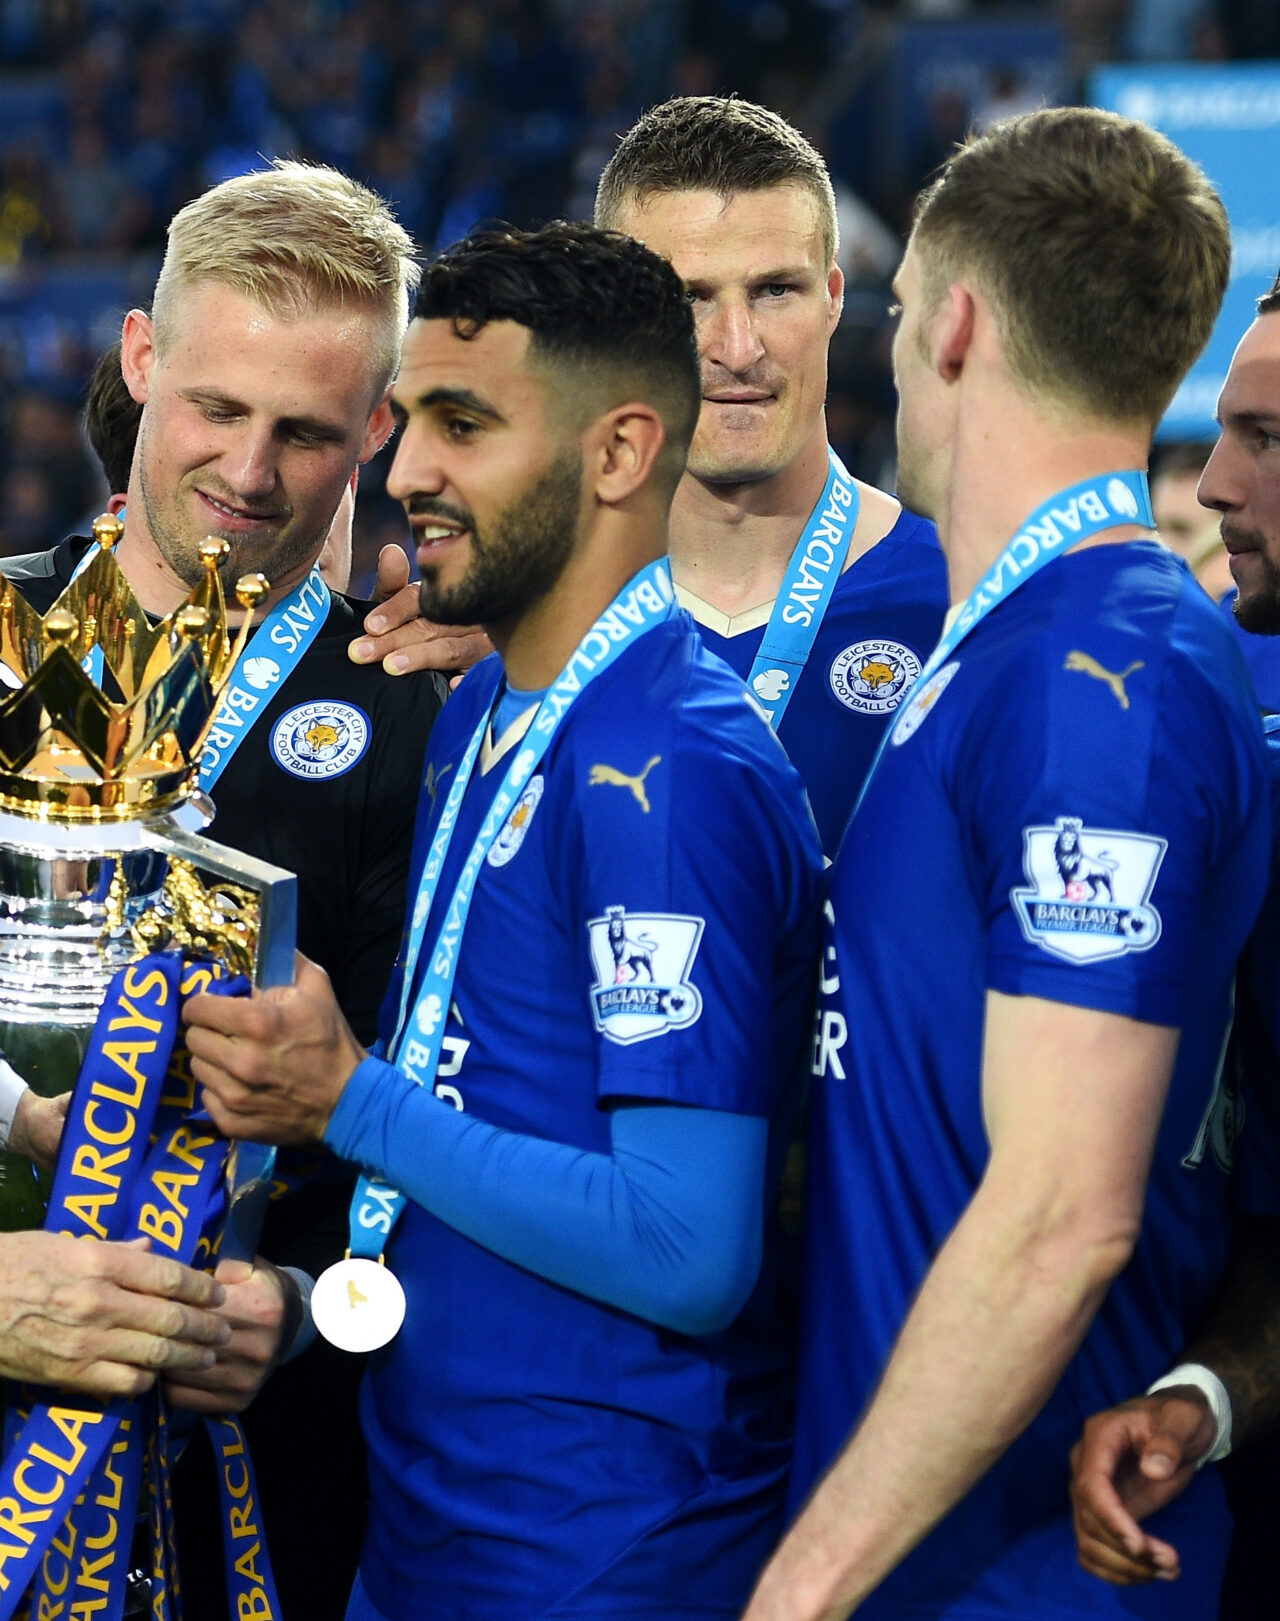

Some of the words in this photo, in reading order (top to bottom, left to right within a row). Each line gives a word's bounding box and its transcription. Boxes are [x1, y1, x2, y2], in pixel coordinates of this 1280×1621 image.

[782, 477, 853, 628] BARCLAYS
[958, 490, 1110, 633] BARCLAYS
[536, 580, 666, 735] BARCLAYS
[838, 643, 905, 668] LEICESTER
[903, 655, 919, 679] CITY
[834, 673, 886, 711] FOOTBALL
[285, 705, 354, 728] LEICESTER
[350, 718, 363, 742] CITY
[278, 733, 323, 774] FOOTBALL
[325, 748, 357, 772] CLUB
[1038, 903, 1121, 925] BARCLAYS
[59, 966, 169, 1241] ARCLAYS
